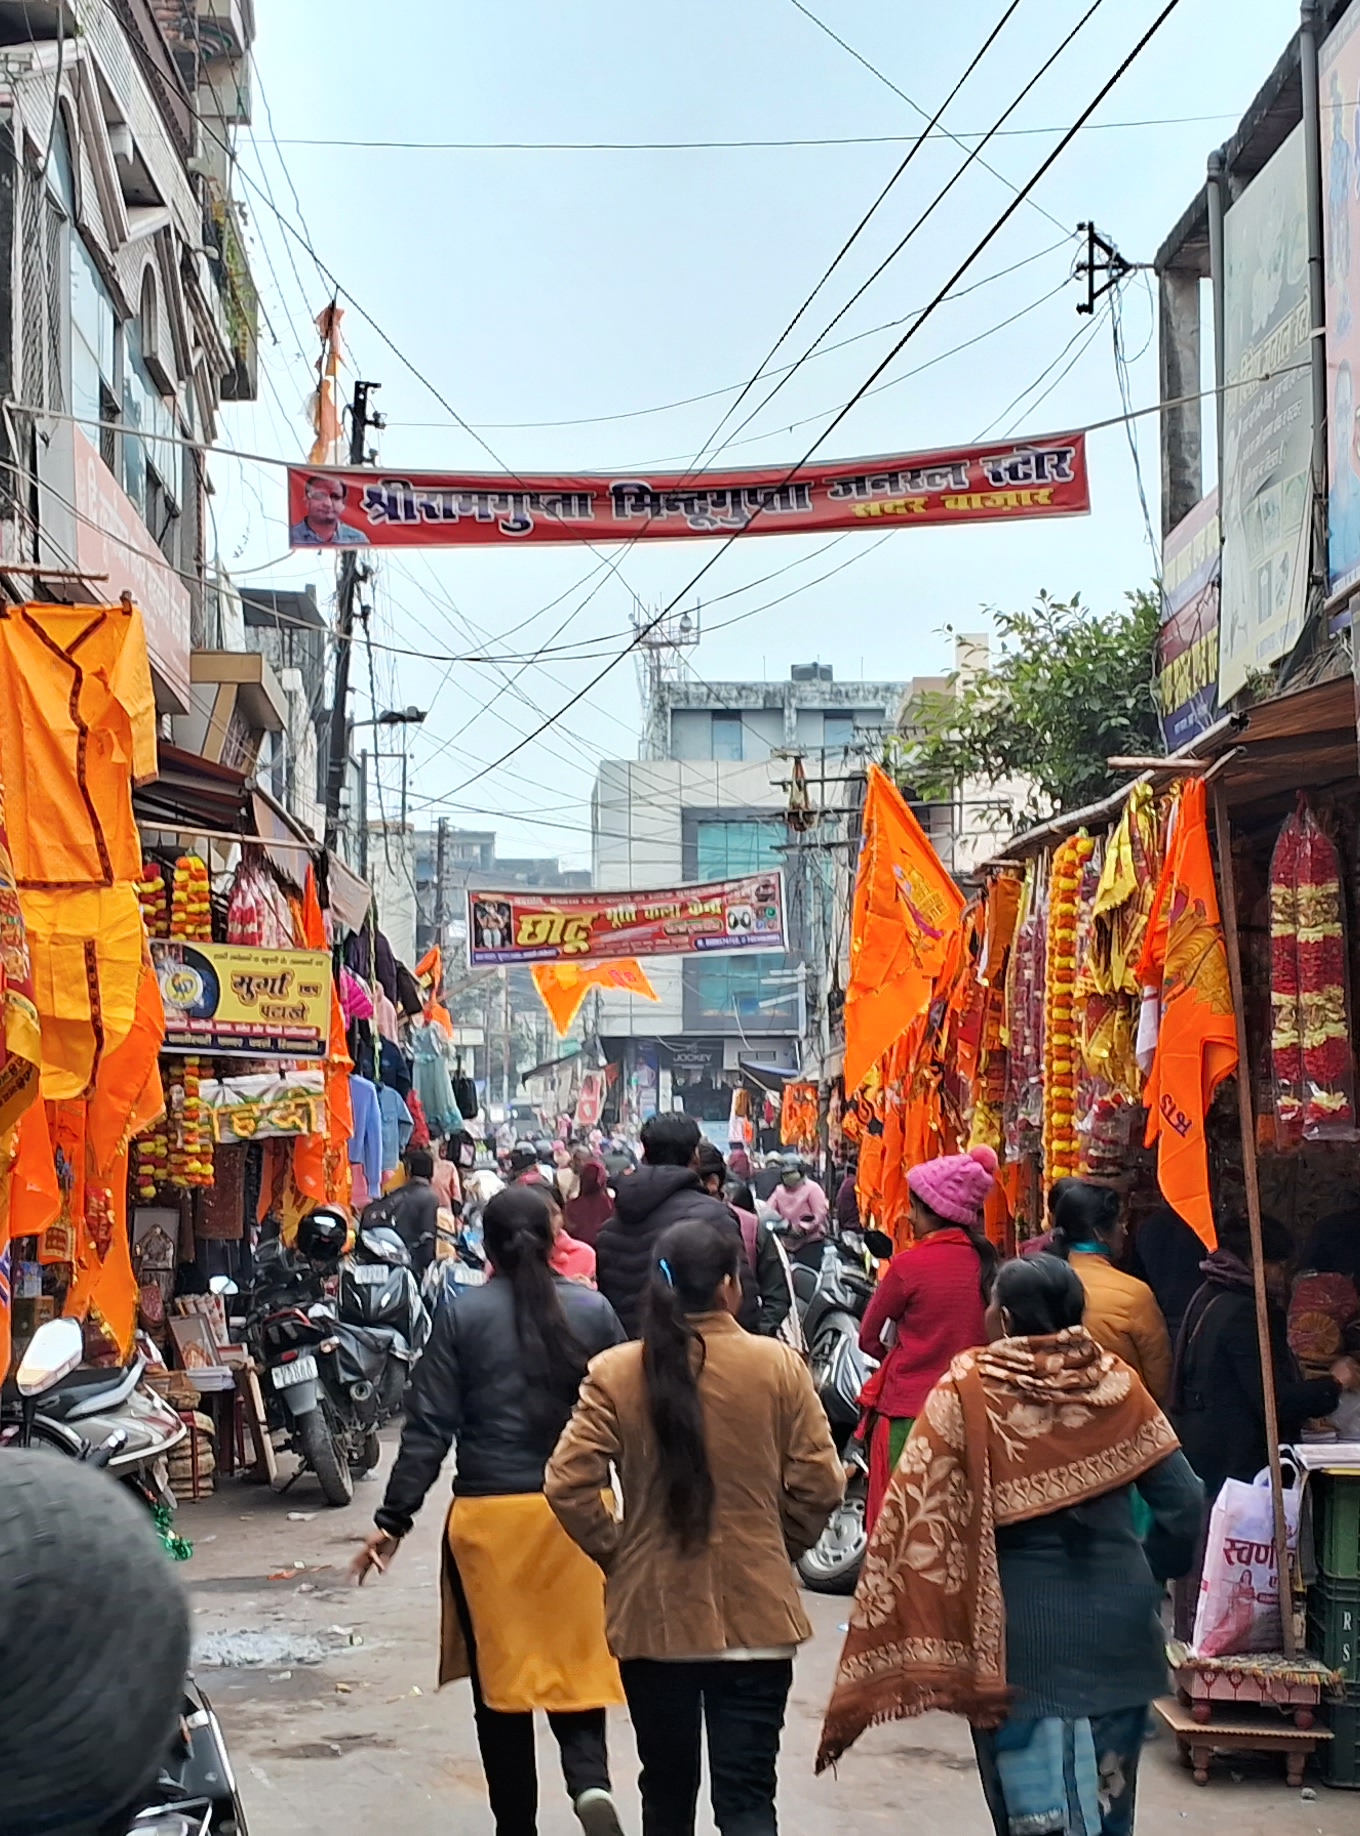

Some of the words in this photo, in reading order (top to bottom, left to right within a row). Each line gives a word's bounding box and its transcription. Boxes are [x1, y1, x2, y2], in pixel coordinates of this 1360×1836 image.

[823, 460, 970, 500] जनरल
[980, 446, 1075, 484] स्टोर
[848, 496, 928, 518] सदर
[516, 907, 598, 953] छोटू
[232, 969, 294, 1006] मुर्गा
[260, 1001, 308, 1021] पटाखे
[673, 1053, 712, 1062] JOCKEY
